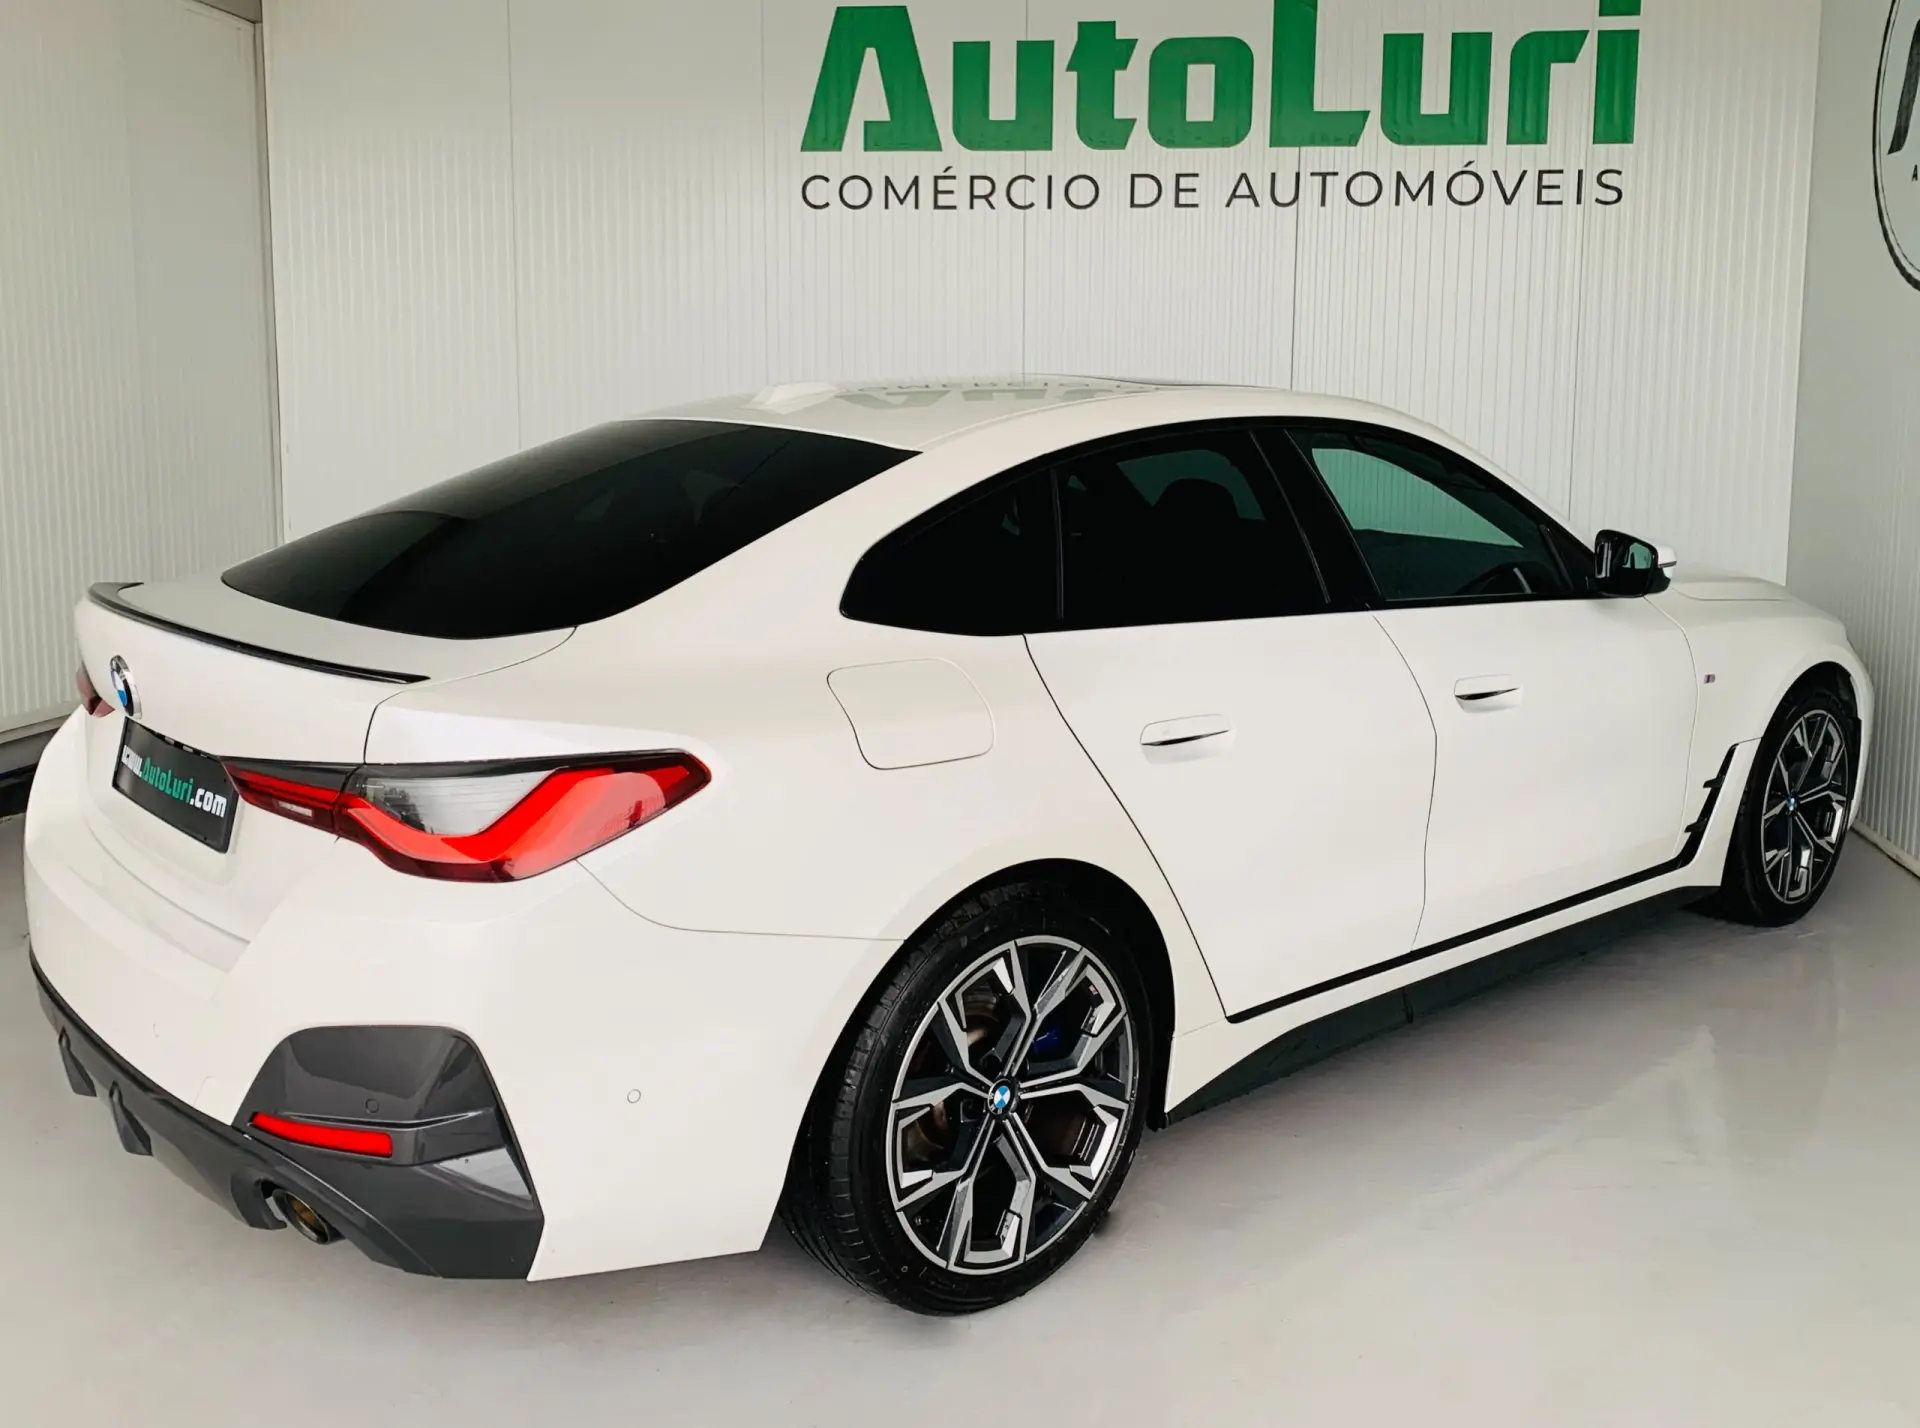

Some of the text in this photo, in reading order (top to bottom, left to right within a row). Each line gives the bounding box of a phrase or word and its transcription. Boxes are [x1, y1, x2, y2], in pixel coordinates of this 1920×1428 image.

[801, 0, 1641, 151] AutoLuri
[801, 161, 1623, 210] COMÉRCIO DE AUTOMÓVEIS
